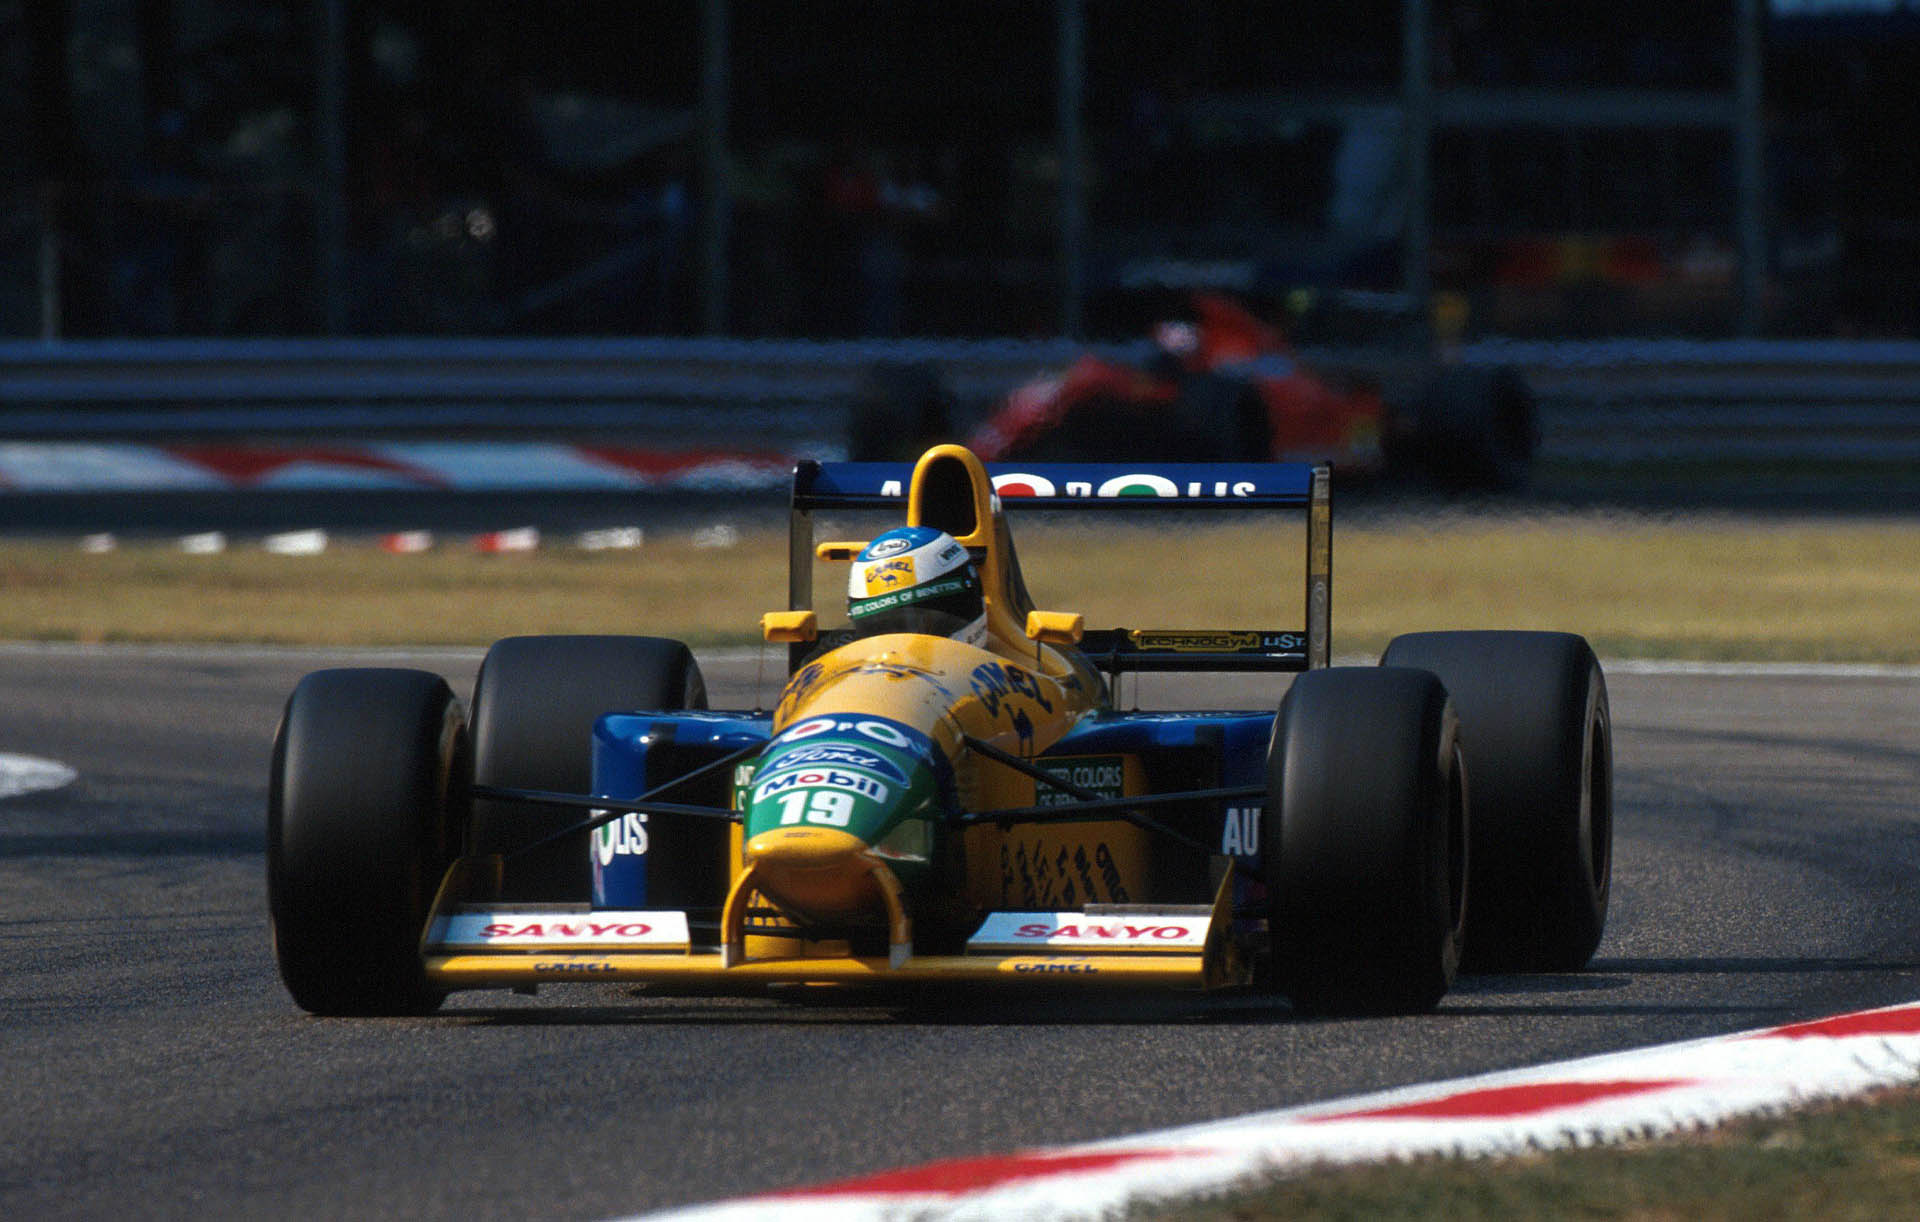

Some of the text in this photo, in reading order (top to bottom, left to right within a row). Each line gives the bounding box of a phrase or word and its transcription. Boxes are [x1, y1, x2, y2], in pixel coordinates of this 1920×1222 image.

[866, 561, 913, 583] CAMEL
[864, 595, 898, 612] COLORS
[900, 591, 913, 602] OF
[1264, 634, 1306, 648] LIST
[776, 747, 880, 769] Ford
[763, 772, 880, 797] Mobil
[1072, 766, 1122, 788] COLORS
[776, 790, 855, 827] 19
[479, 923, 652, 938] SANYO
[1013, 924, 1189, 939] SANYO
[533, 962, 618, 973] CAMEL
[1014, 963, 1099, 974] CAMEL
